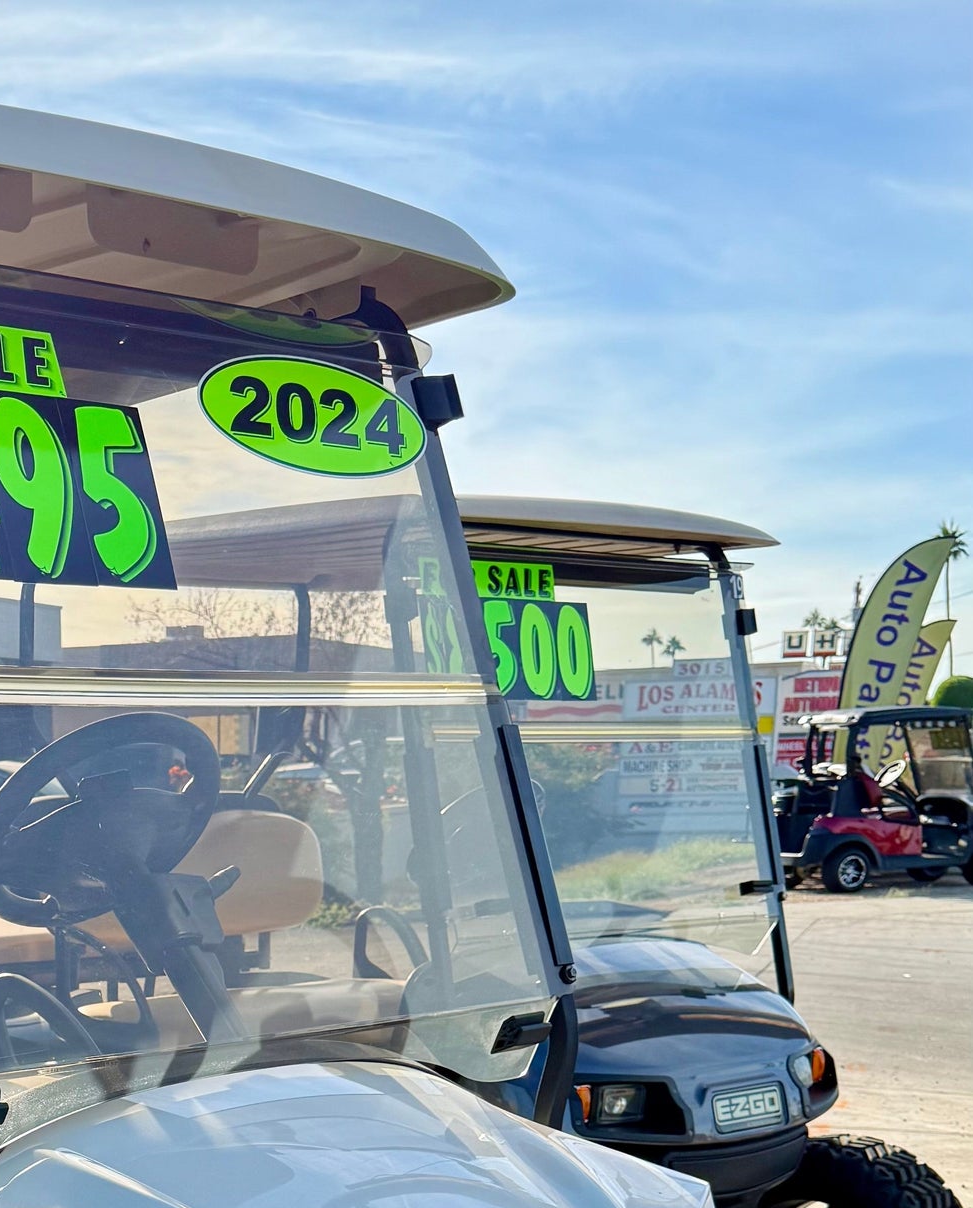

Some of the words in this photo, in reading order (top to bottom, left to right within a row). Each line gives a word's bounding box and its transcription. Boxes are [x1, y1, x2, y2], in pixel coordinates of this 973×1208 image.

[229, 375, 408, 459] 2024
[487, 565, 551, 598] SALE
[876, 559, 928, 647] Auto
[678, 662, 725, 676] 3015
[898, 637, 937, 705] Auto
[595, 684, 624, 700] ELI
[637, 684, 674, 711] LOS
[680, 681, 763, 707] ALAMS
[661, 704, 736, 715] CENTER
[622, 759, 665, 773] MACHINE
[666, 759, 693, 773] SHOP
